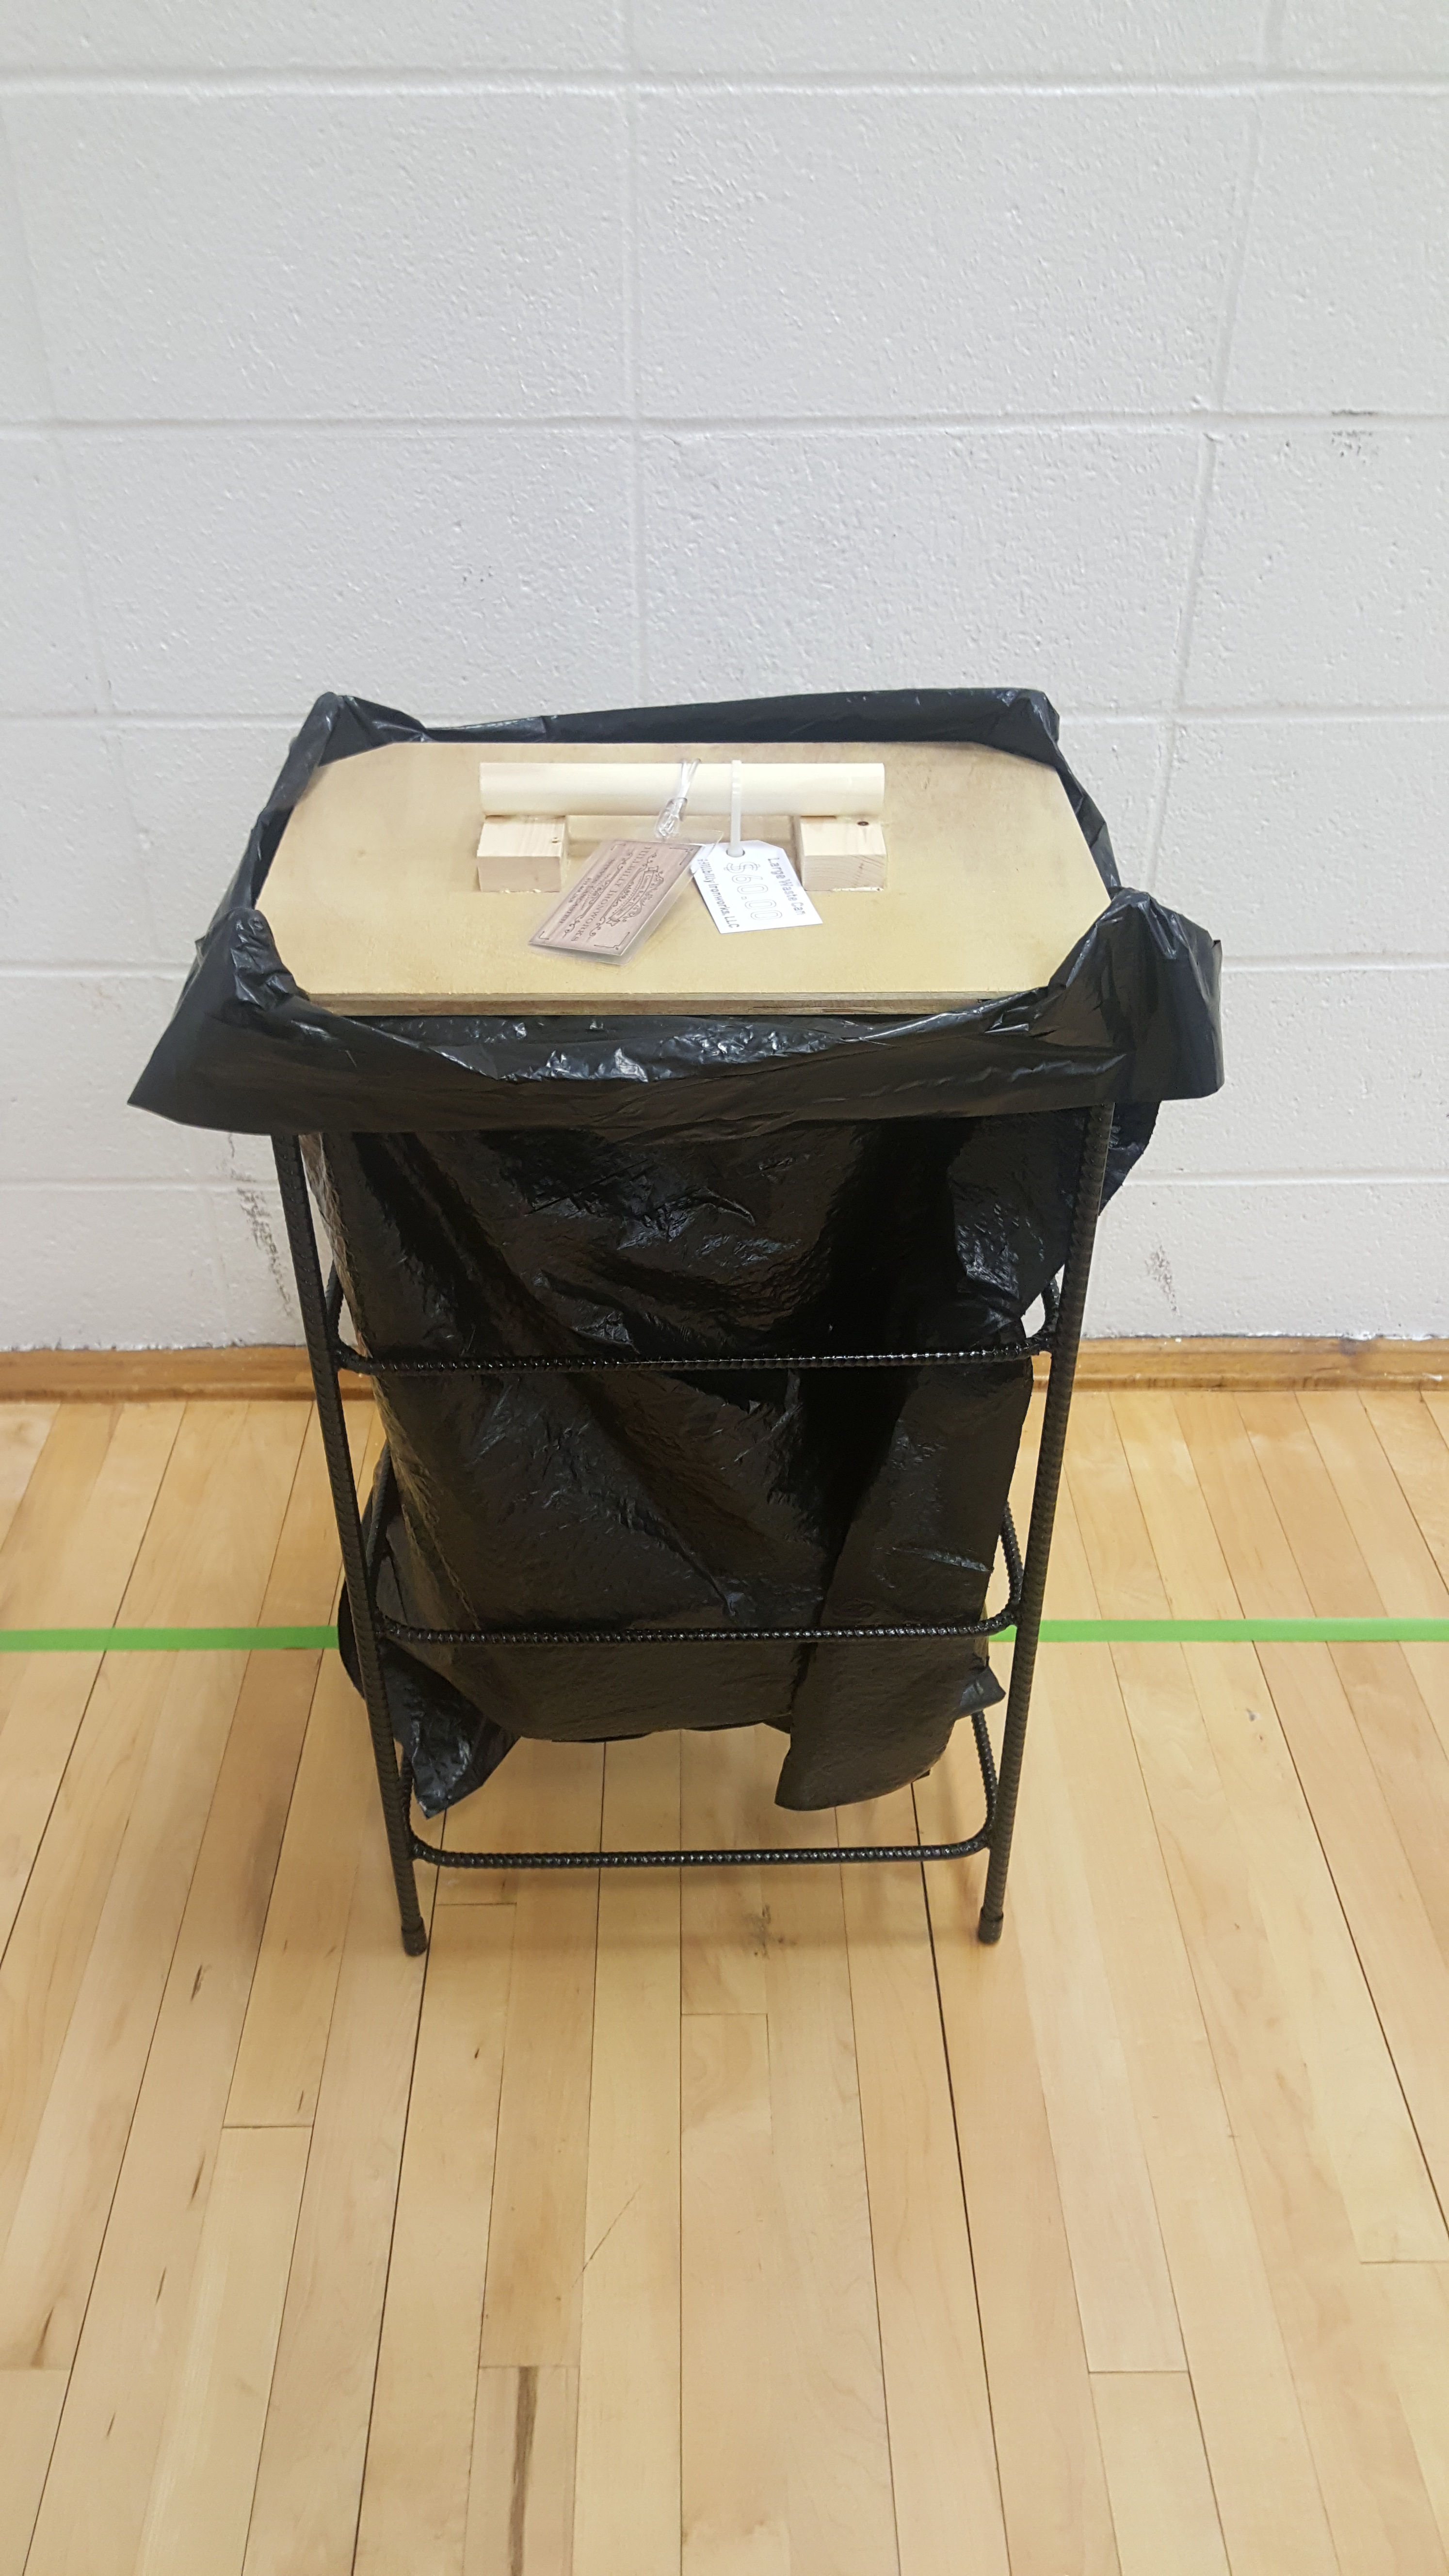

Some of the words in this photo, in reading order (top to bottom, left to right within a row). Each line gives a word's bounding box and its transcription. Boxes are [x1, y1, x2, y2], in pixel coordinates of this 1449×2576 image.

[724, 862, 782, 920] $60.00
[768, 858, 785, 879] Large
[780, 879, 797, 901] Waste
[791, 902, 805, 915] Can
[571, 890, 618, 942] IRONWORKS
[724, 916, 740, 928] LLC
